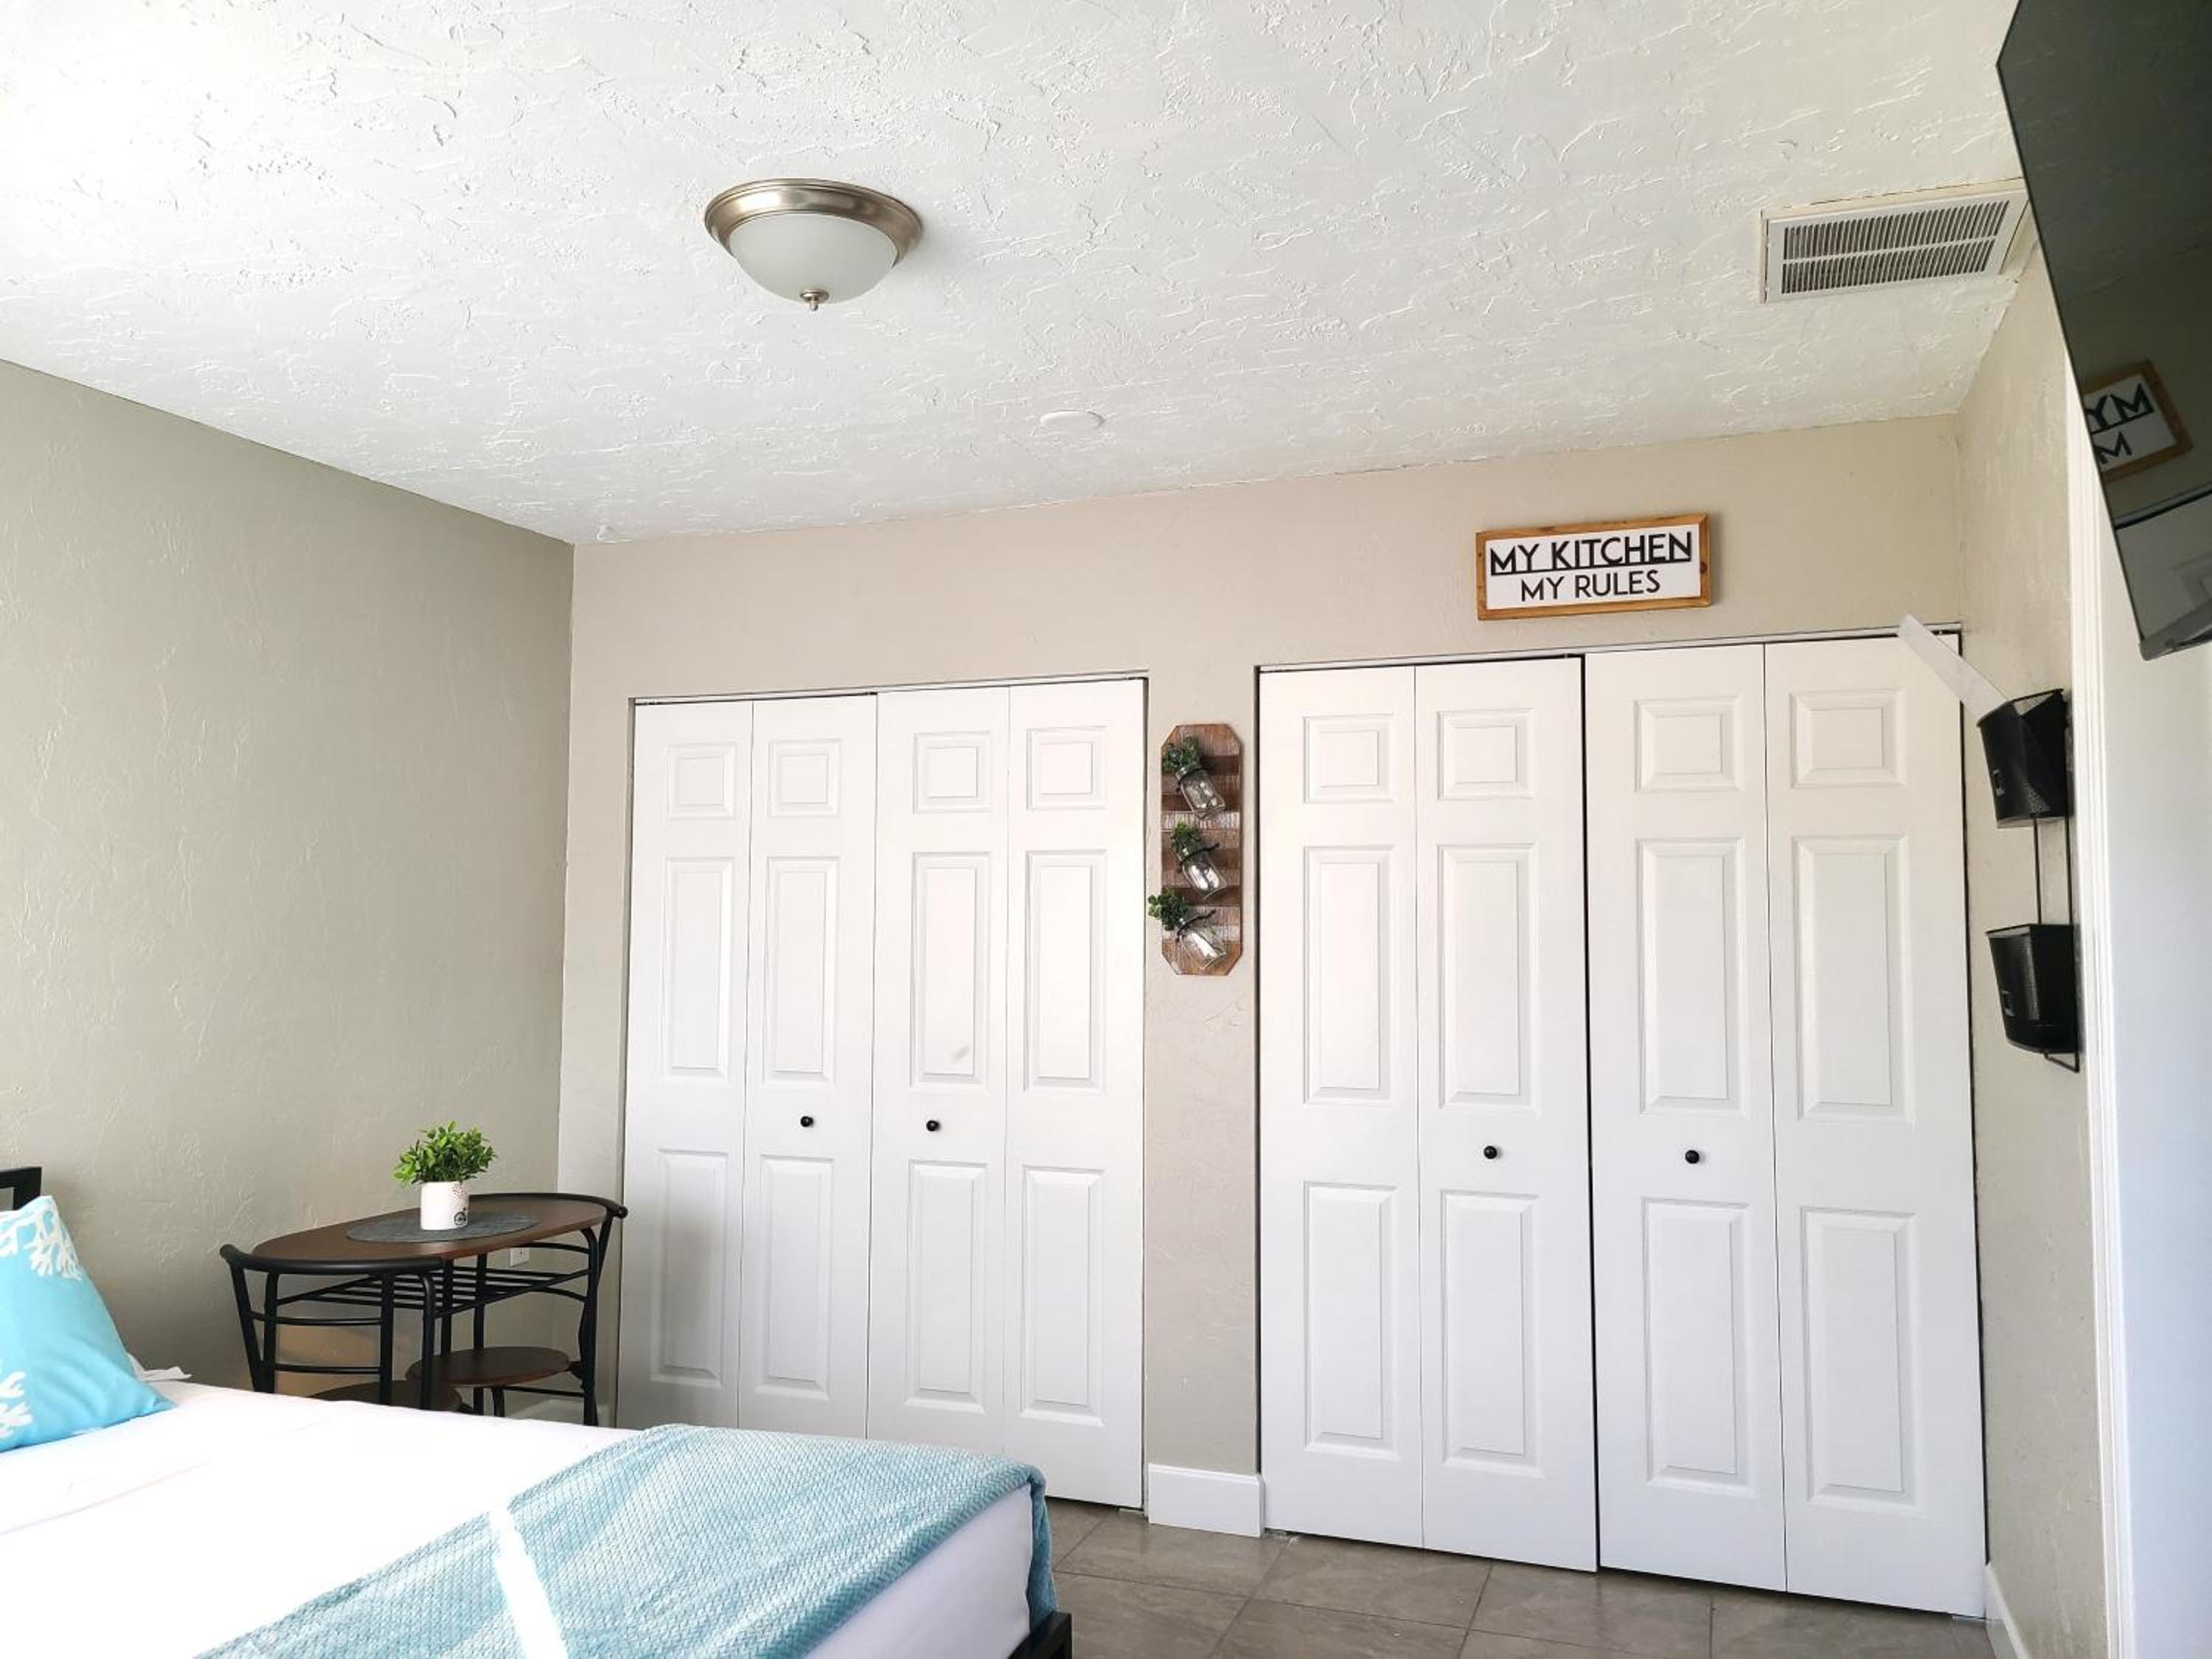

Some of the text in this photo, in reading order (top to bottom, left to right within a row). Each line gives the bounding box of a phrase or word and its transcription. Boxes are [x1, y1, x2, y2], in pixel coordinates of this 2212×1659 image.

[1490, 532, 1691, 574] MY KITCHEN
[1521, 569, 1661, 602] MY RULES
